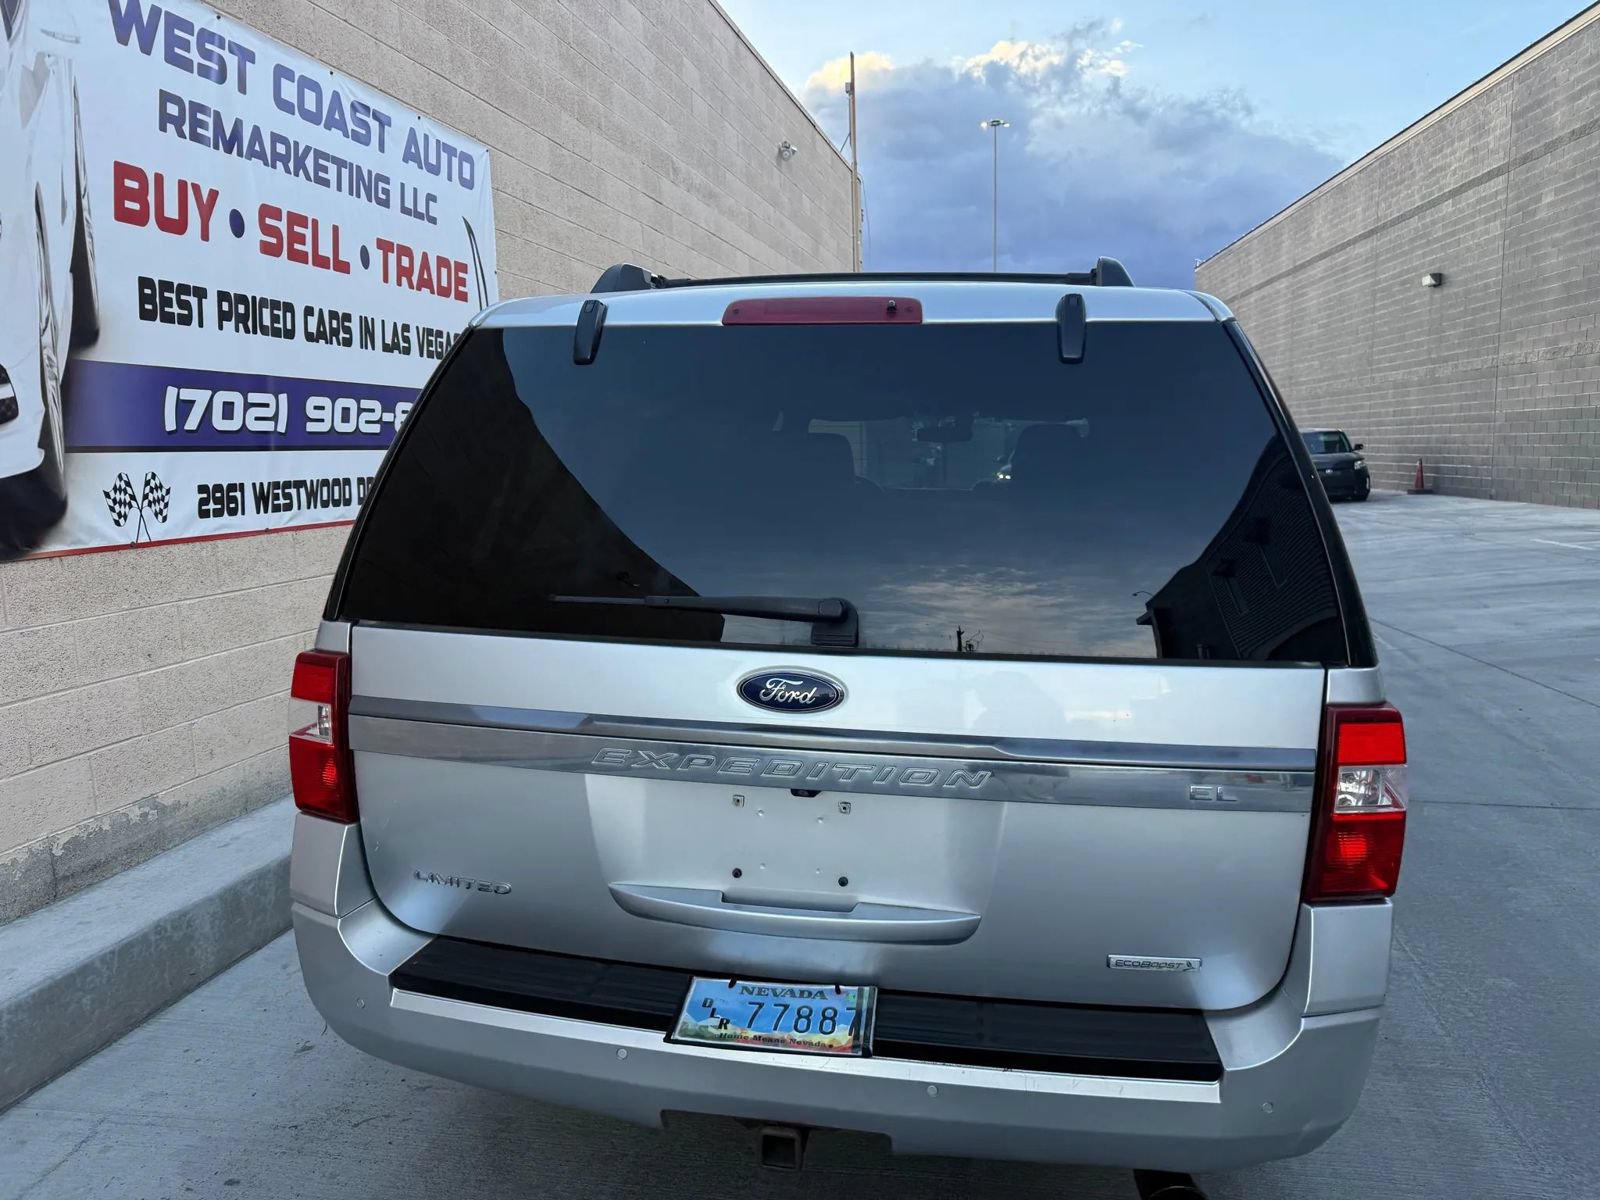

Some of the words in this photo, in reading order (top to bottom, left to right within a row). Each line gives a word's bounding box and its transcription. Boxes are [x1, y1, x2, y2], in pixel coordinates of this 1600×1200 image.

[108, 0, 256, 95] WEST
[272, 62, 392, 154] COAST
[401, 125, 475, 190] AUTO
[158, 89, 391, 208] REMARKETING
[400, 182, 437, 225] LLC
[113, 160, 220, 242] BUY
[258, 202, 351, 275] SELL
[376, 237, 469, 302] TRADE
[137, 275, 207, 328] BEST
[217, 291, 296, 340] PRICED
[304, 305, 352, 348] CARS
[359, 315, 375, 351] IN
[381, 319, 411, 356] LAS
[415, 325, 461, 361] VEGA
[164, 385, 288, 434] (702)
[197, 483, 245, 519] 2961
[252, 477, 352, 513] WESTWOOD
[759, 677, 816, 706] Ford
[591, 747, 993, 789] EXPEDITION
[1189, 785, 1239, 802] EL
[413, 869, 512, 895] LIMITED
[738, 985, 829, 1001] NEVADA
